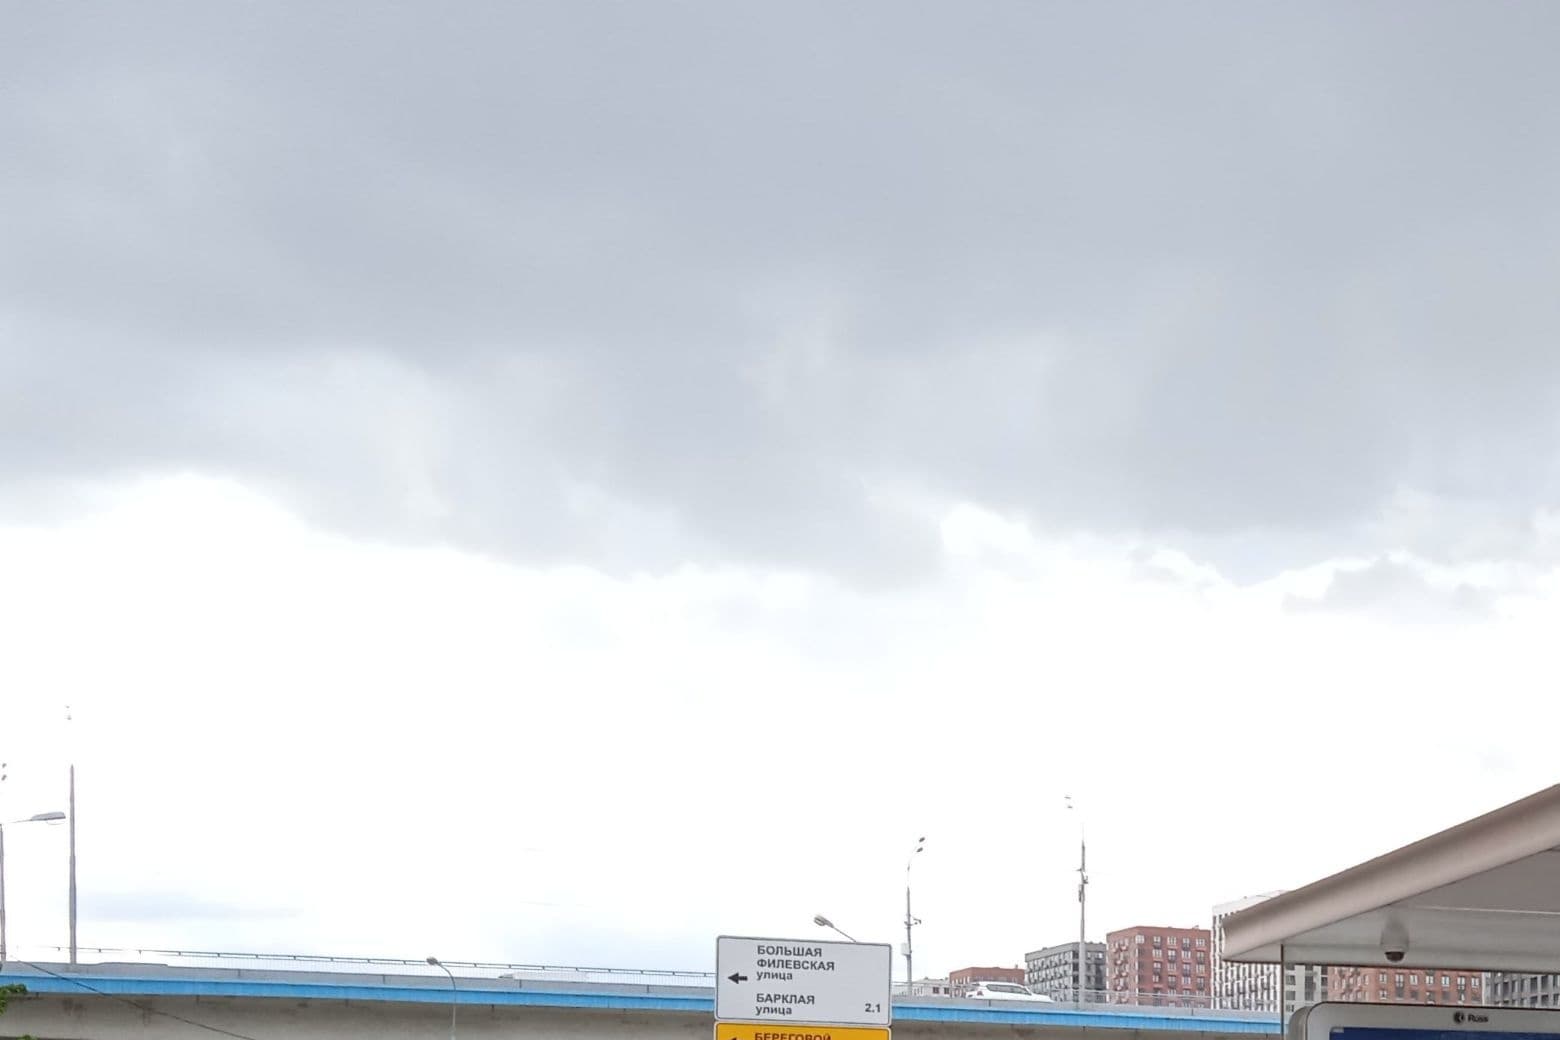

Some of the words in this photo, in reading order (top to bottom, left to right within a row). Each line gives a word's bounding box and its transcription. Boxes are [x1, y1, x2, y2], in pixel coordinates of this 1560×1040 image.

[757, 945, 822, 957] БОЛЬШАЯ
[756, 959, 835, 971] ФИЛЕВСКАЯ
[756, 970, 793, 981] улица
[756, 993, 815, 1005] БАРКЛАЯ
[755, 1005, 792, 1016] улица
[864, 1003, 881, 1013] 2.1
[1467, 1013, 1489, 1023] Russ
